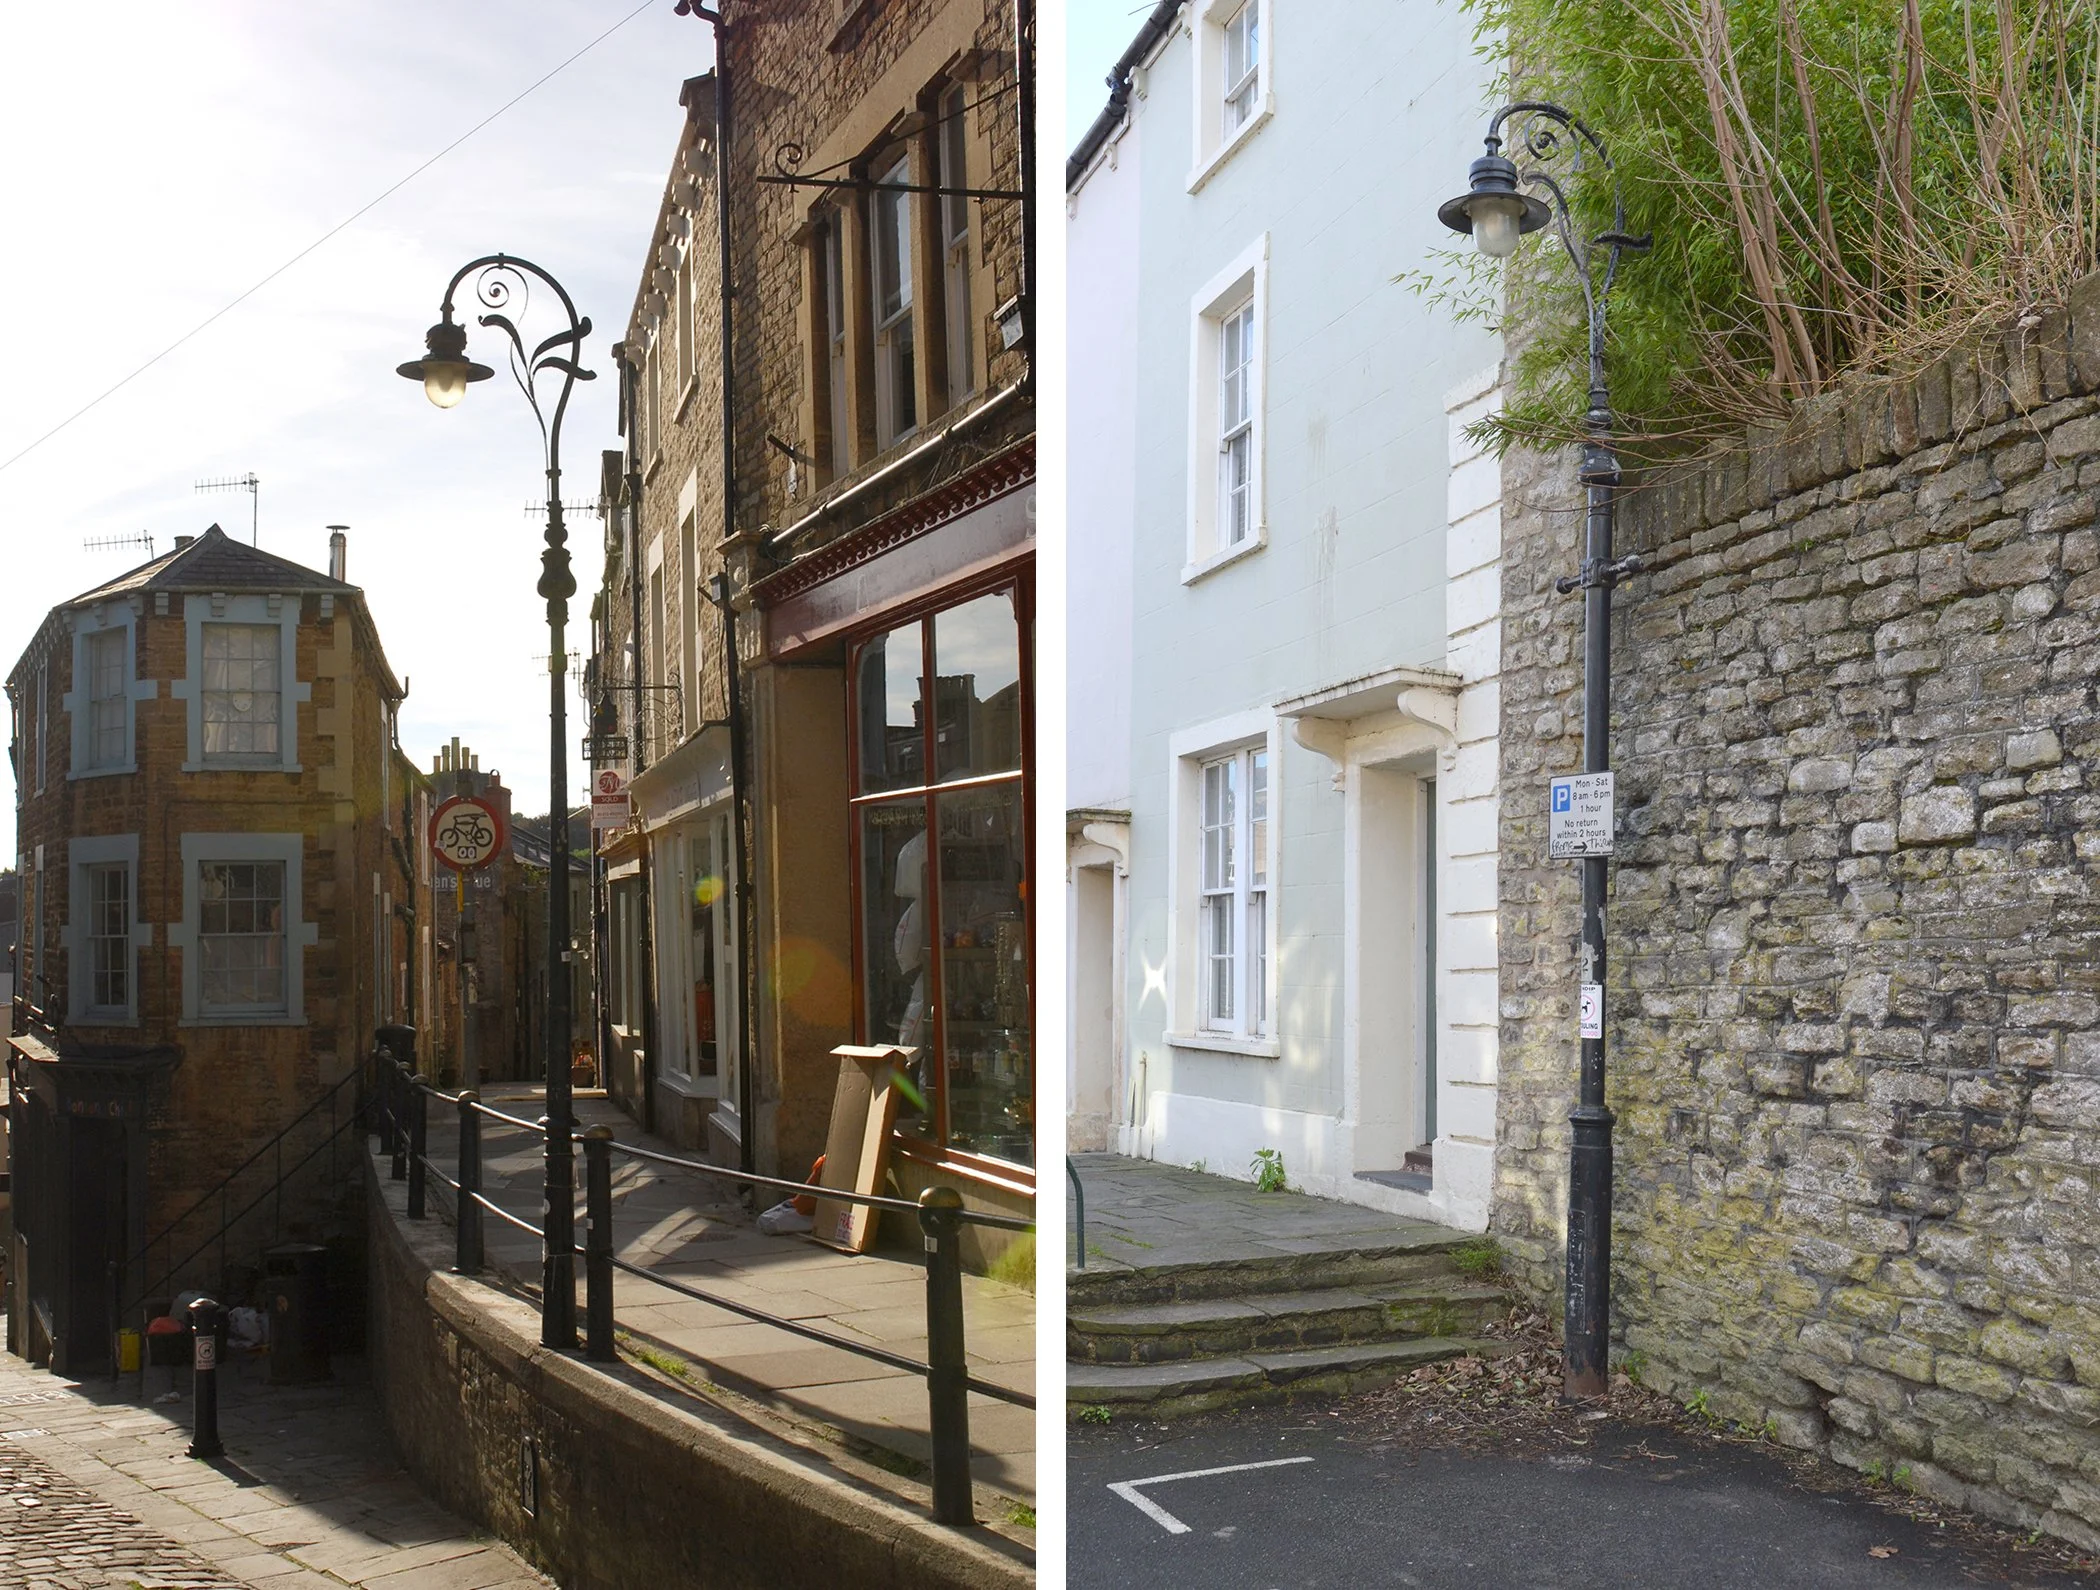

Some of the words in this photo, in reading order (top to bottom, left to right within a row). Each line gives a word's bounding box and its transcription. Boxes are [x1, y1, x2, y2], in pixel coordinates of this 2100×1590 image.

[1575, 780, 1590, 788] Mon
[1595, 777, 1608, 786] Sat
[1557, 788, 1568, 810] P
[1585, 804, 1602, 813] hour
[1564, 820, 1574, 828] No
[1576, 819, 1598, 827] return
[1557, 831, 1577, 839] within
[1579, 829, 1584, 837] 2
[1586, 829, 1606, 837] hours
